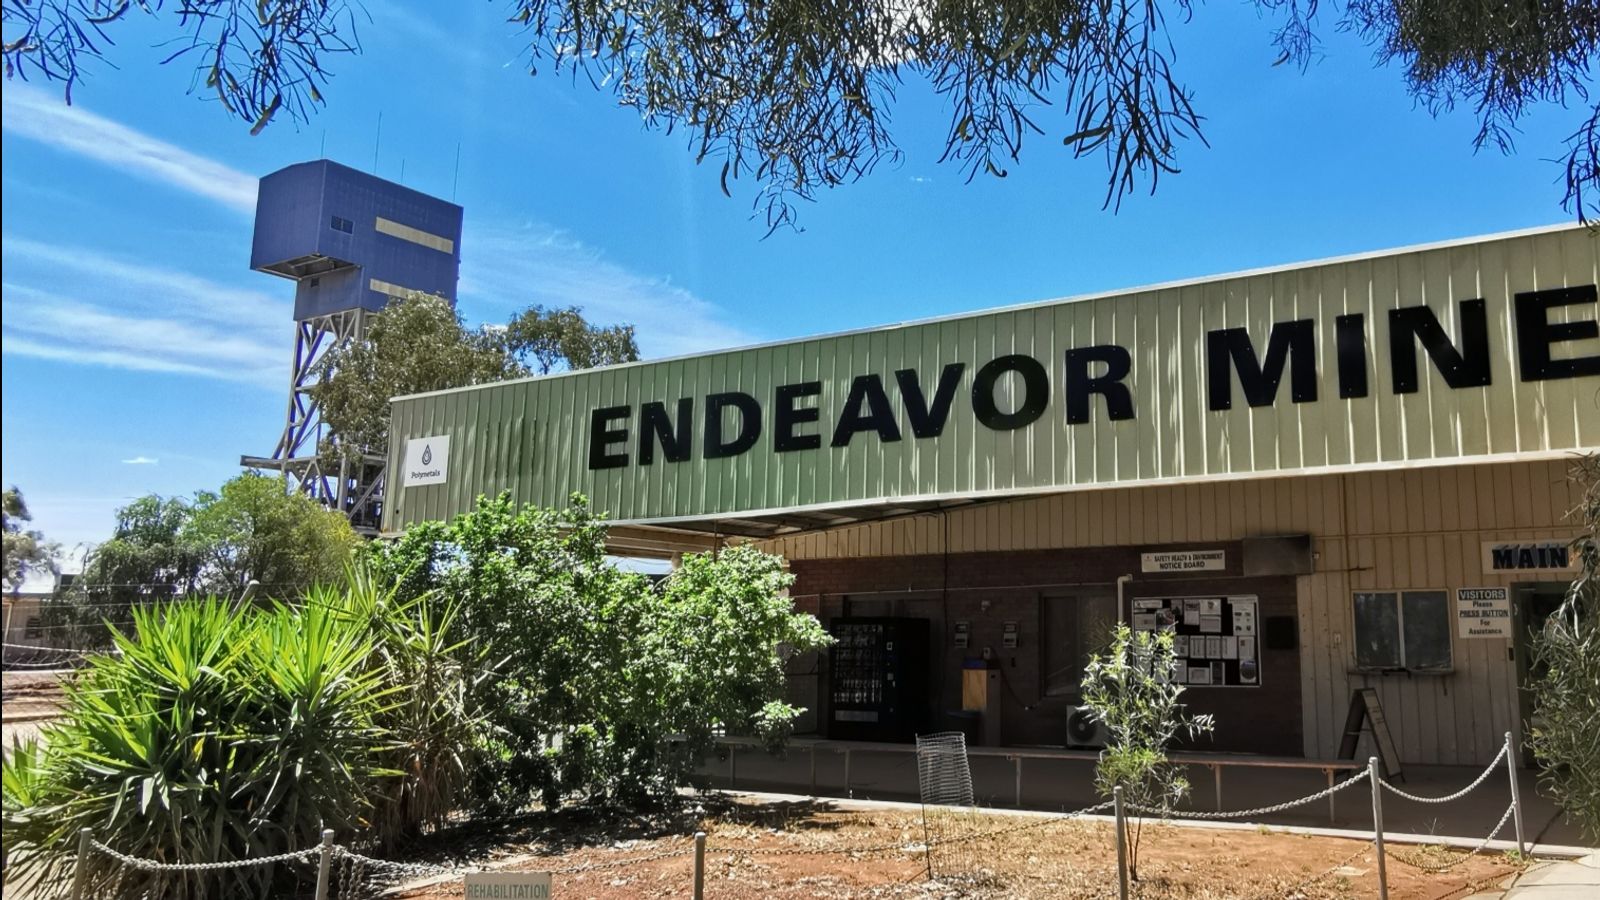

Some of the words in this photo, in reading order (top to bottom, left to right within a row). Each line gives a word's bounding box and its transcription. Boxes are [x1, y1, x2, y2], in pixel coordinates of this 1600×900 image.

[589, 345, 1135, 470] ENDEAVOR
[1207, 284, 1600, 411] MINE
[411, 469, 440, 479] Polymetals
[1492, 543, 1568, 570] MAIN
[1160, 562, 1182, 570] NOTICE
[1184, 561, 1205, 569] BOARD
[1459, 590, 1505, 600] VISITORS
[1459, 610, 1480, 618] PRESS
[1481, 609, 1508, 617] BUTTON
[467, 884, 549, 899] REHABILITATION
